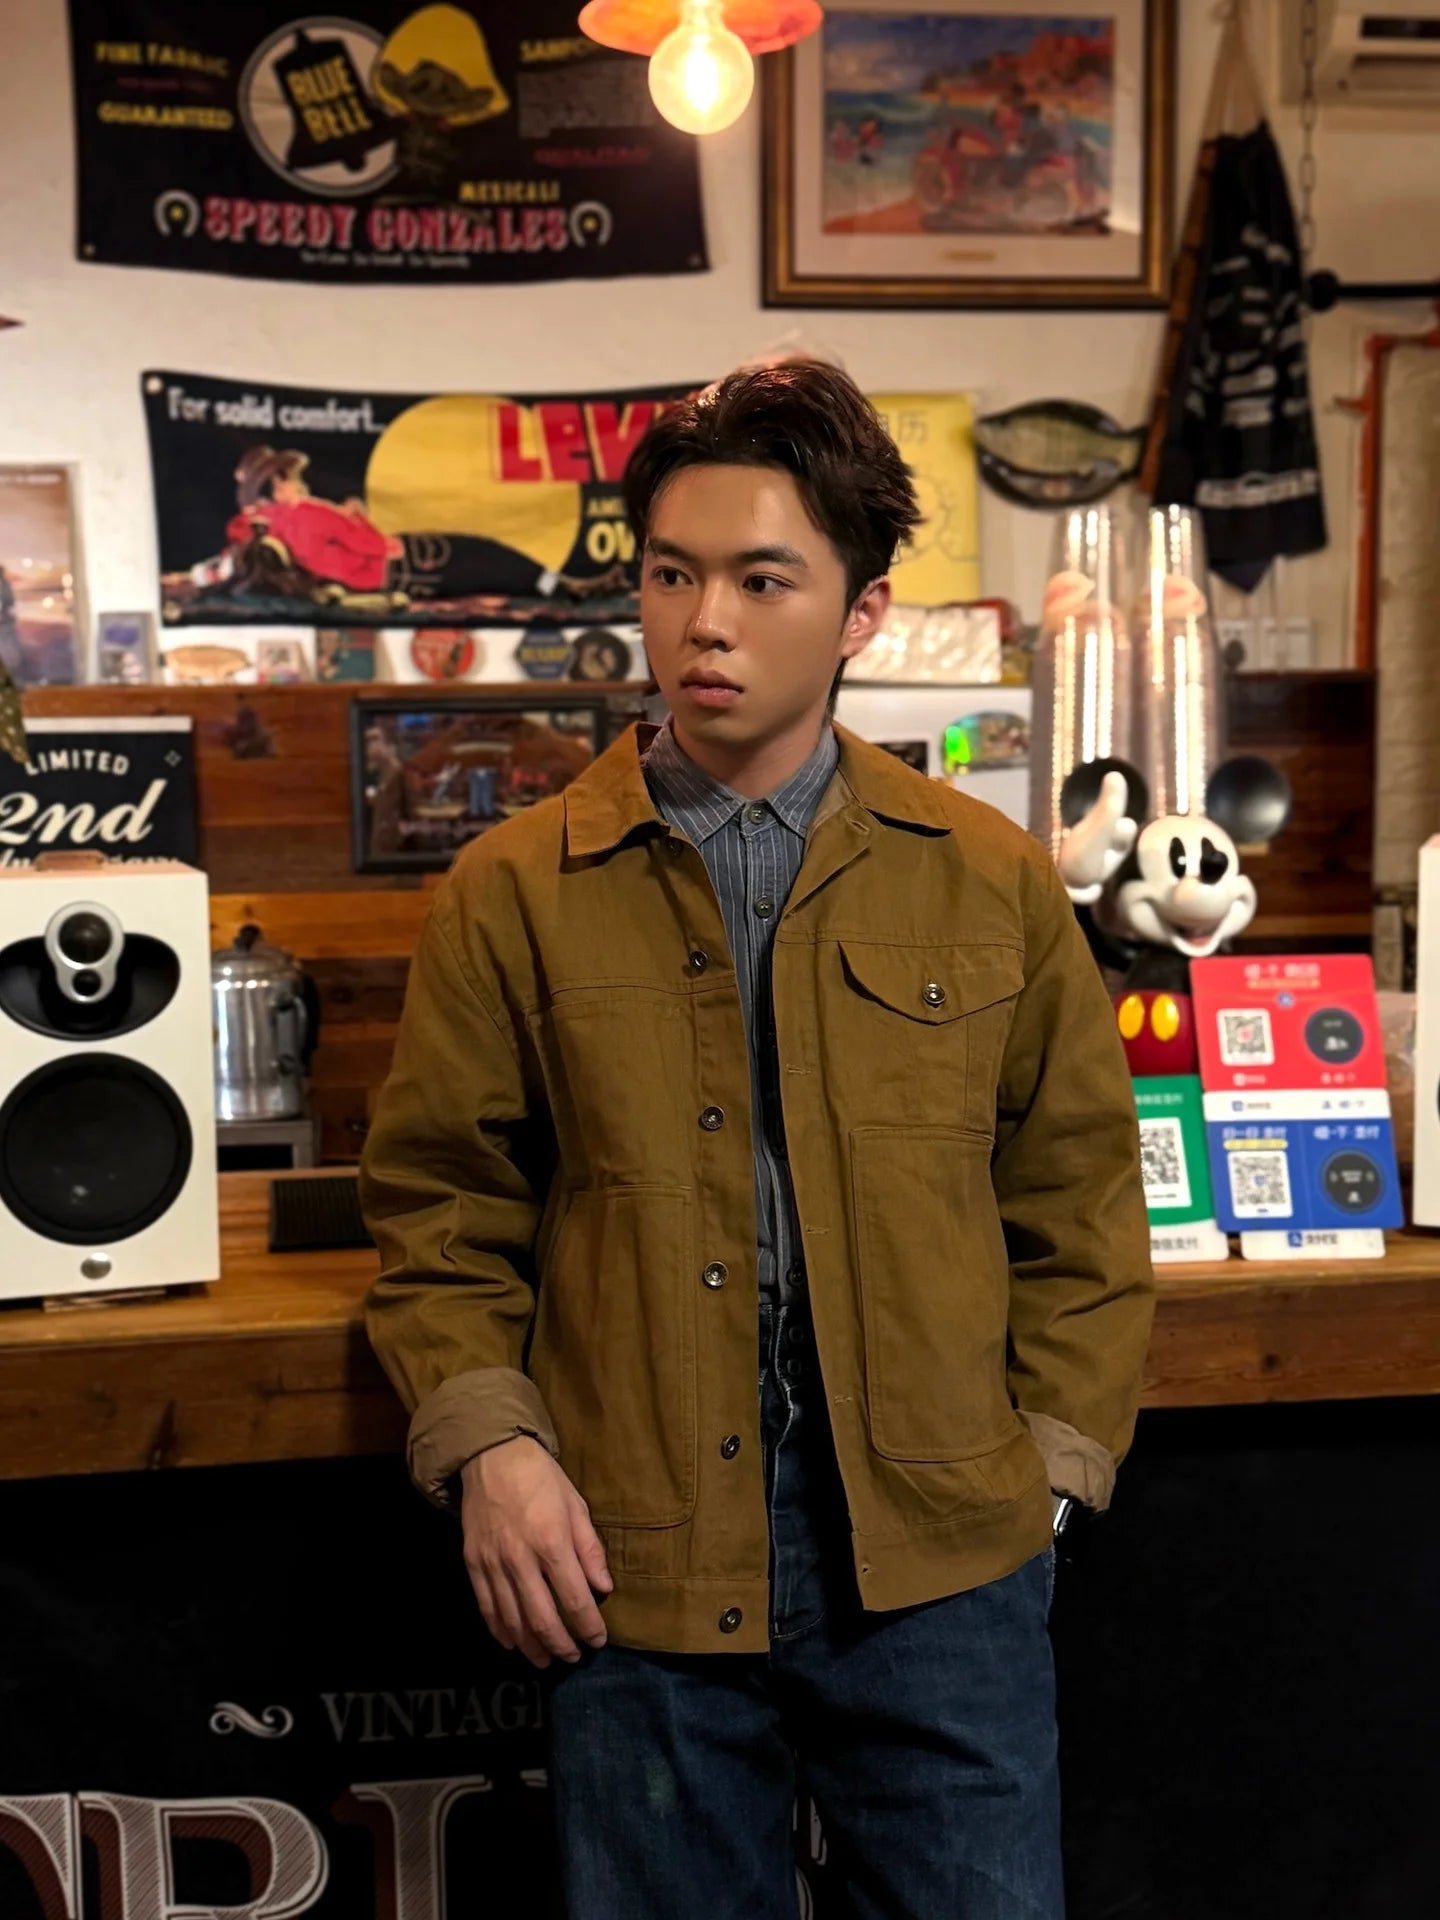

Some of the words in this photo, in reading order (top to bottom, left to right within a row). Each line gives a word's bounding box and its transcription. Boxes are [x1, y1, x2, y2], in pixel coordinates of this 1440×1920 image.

[287, 56, 352, 104] BLUE
[304, 97, 371, 143] BELL
[204, 196, 356, 248] SPEEDY
[366, 207, 569, 252] GONZALES
[167, 387, 208, 421] For
[215, 394, 275, 429] solid
[25, 749, 130, 776] LIMITED
[0, 778, 168, 845] 2nd
